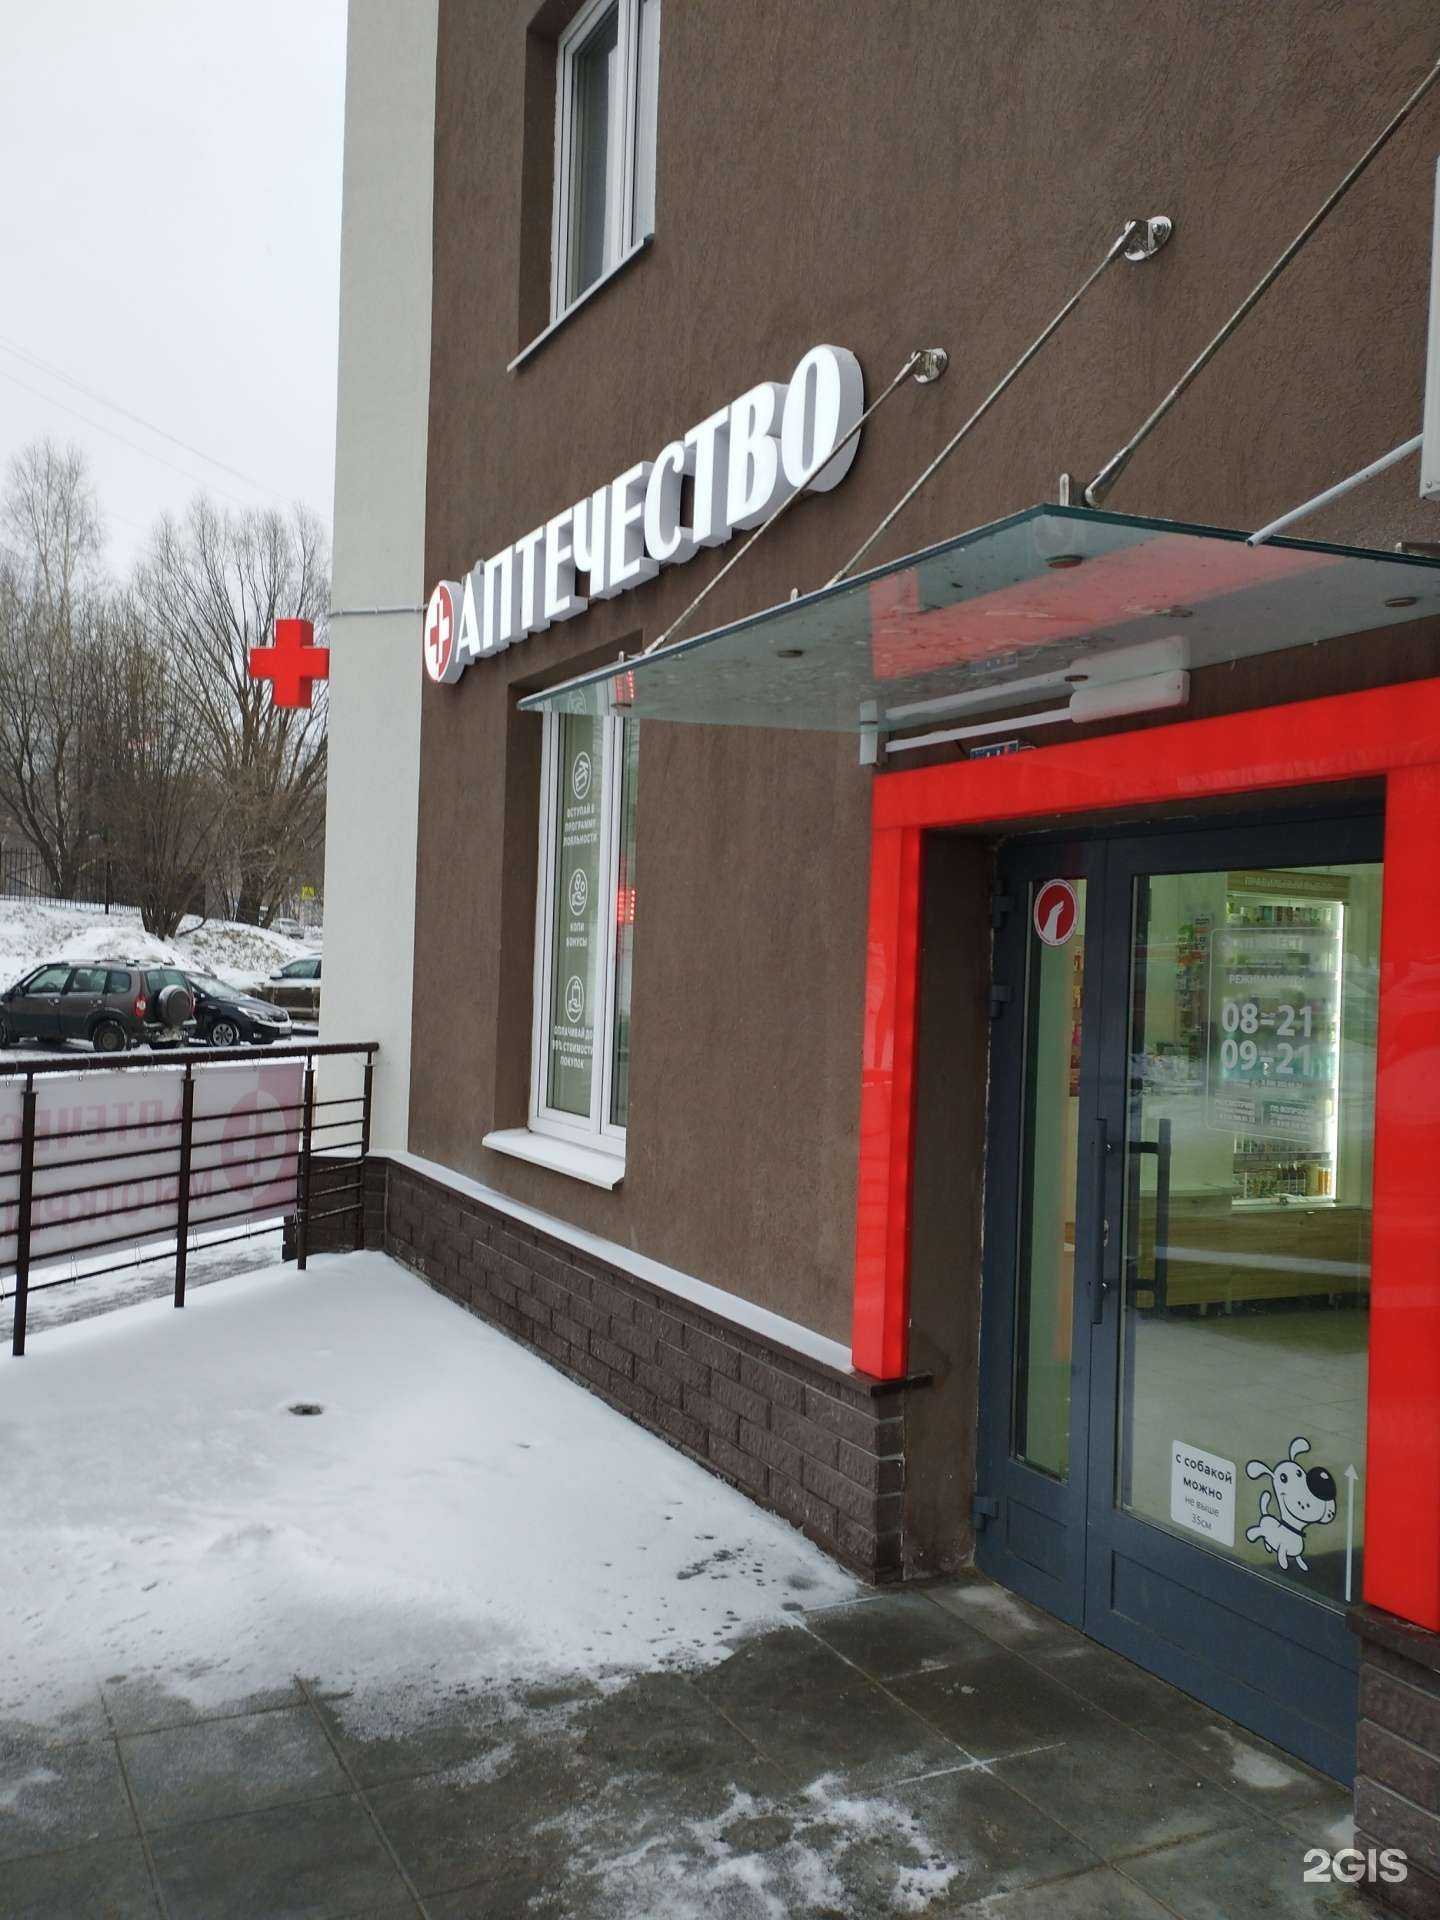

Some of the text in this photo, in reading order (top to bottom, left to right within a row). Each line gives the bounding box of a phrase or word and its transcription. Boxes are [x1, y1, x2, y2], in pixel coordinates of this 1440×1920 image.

[455, 343, 862, 667] АПТЕЧЕСТВО
[1184, 1455, 1233, 1484] собакой
[1183, 1477, 1223, 1501] можно
[1185, 1497, 1220, 1516] не выше
[1191, 1513, 1213, 1531] 35см
